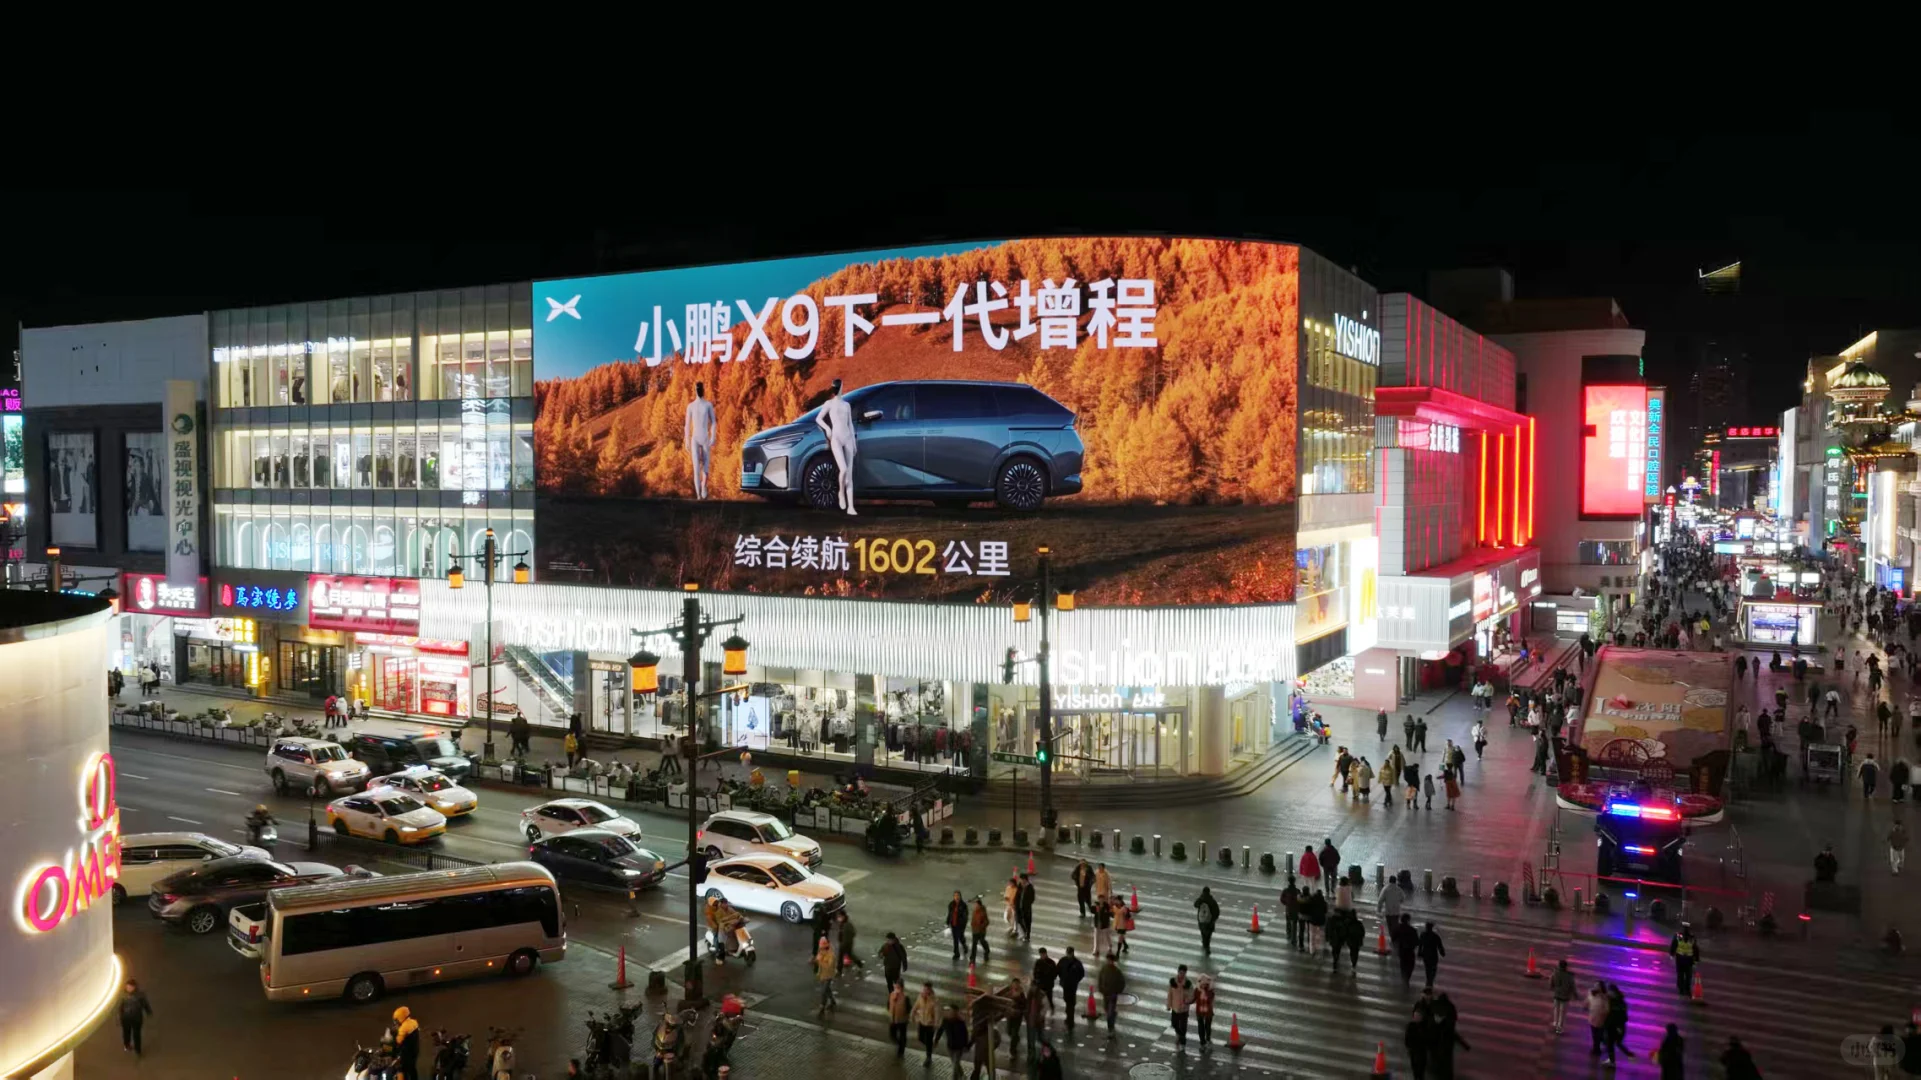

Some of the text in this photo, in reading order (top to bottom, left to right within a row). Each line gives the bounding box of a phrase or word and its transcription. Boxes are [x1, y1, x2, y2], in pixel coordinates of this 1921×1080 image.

[634, 277, 1158, 367] 小鹏X9下一代增程
[1335, 311, 1380, 366] YISHion
[1645, 398, 1662, 496] 奥新全民口腔医院
[174, 440, 194, 556] 盛视视光中心
[1827, 458, 1839, 510] 何氏眼科
[734, 534, 1011, 576] 综合续航1602公里
[1054, 688, 1122, 710] YISHion
